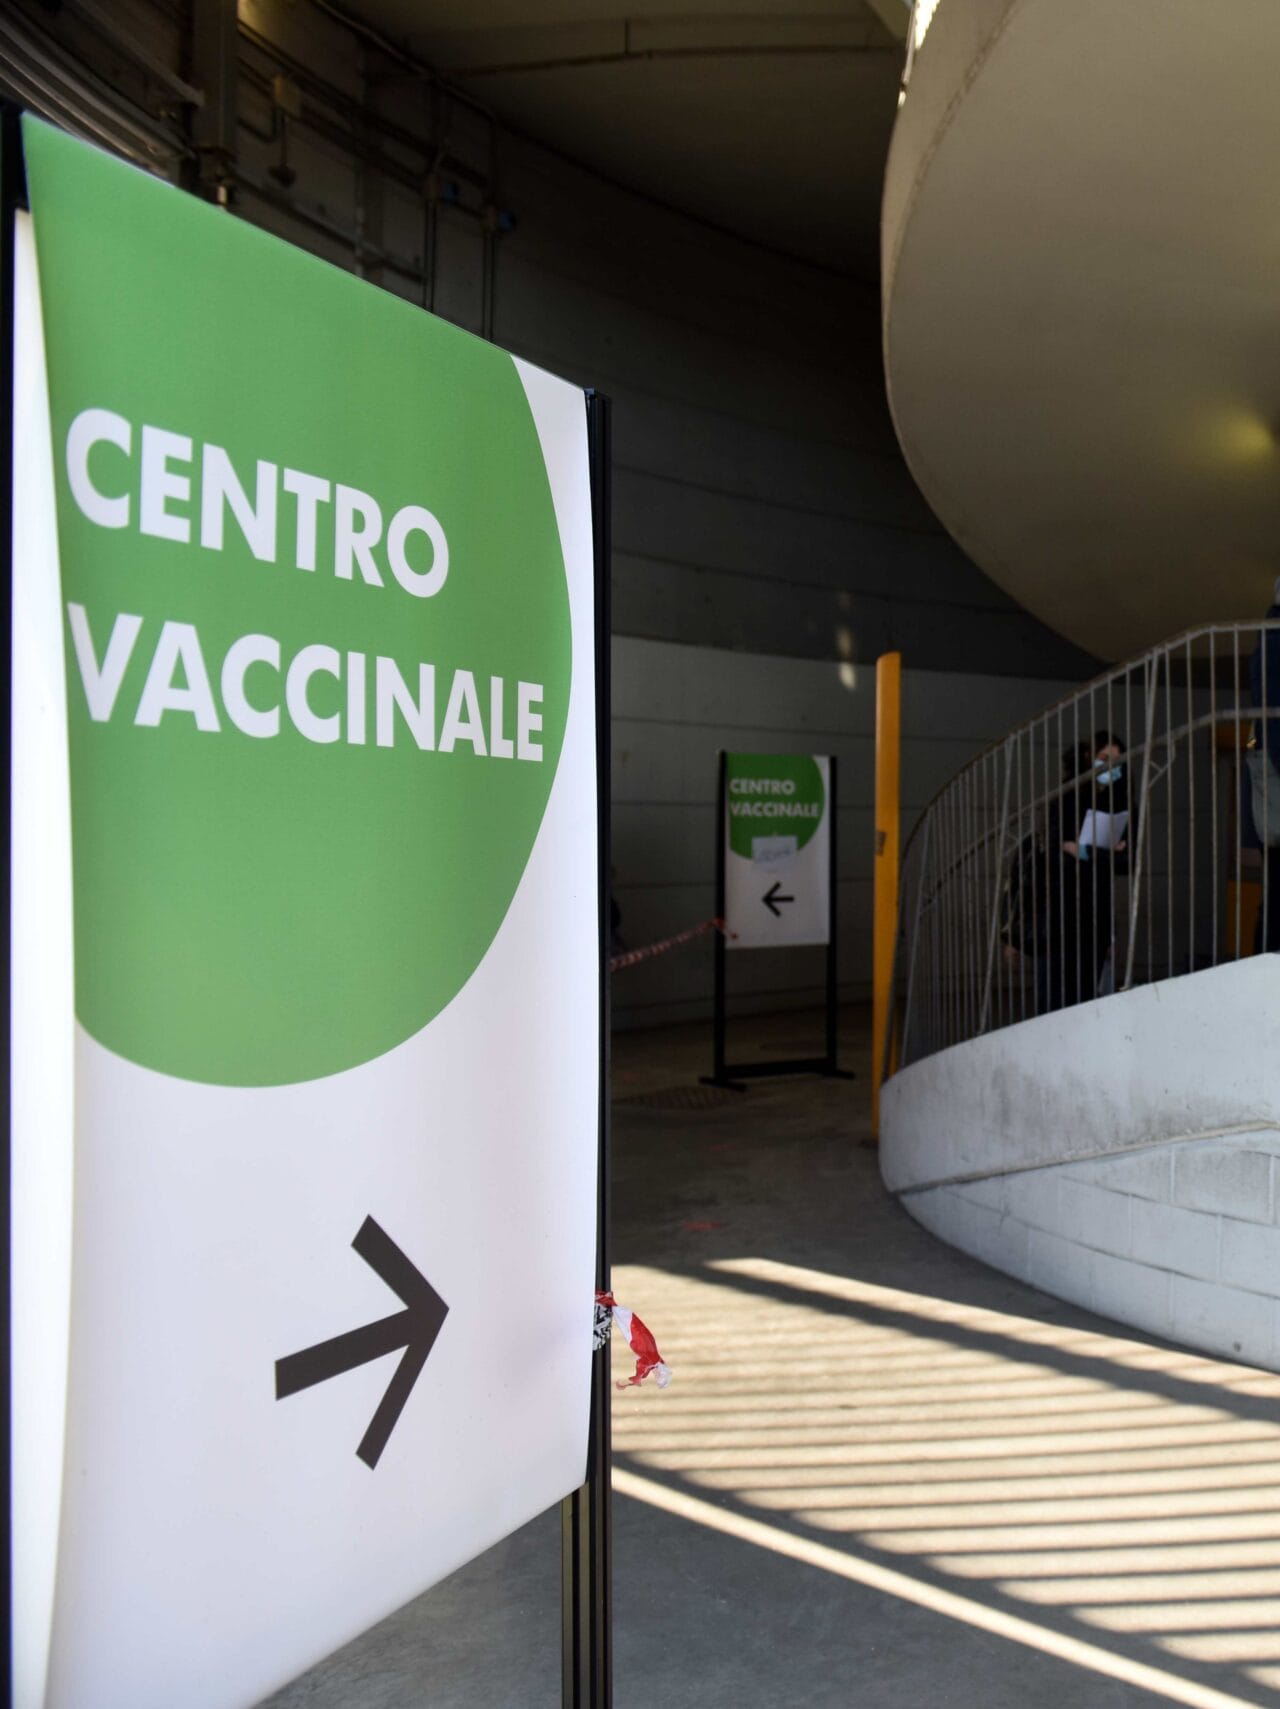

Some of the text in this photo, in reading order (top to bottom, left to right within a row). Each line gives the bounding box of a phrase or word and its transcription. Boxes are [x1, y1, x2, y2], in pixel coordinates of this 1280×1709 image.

[66, 408, 449, 597] CENTRO
[67, 602, 543, 762] VACCINALE
[729, 778, 796, 796] CENTRO
[730, 801, 819, 818] VACCINALE
